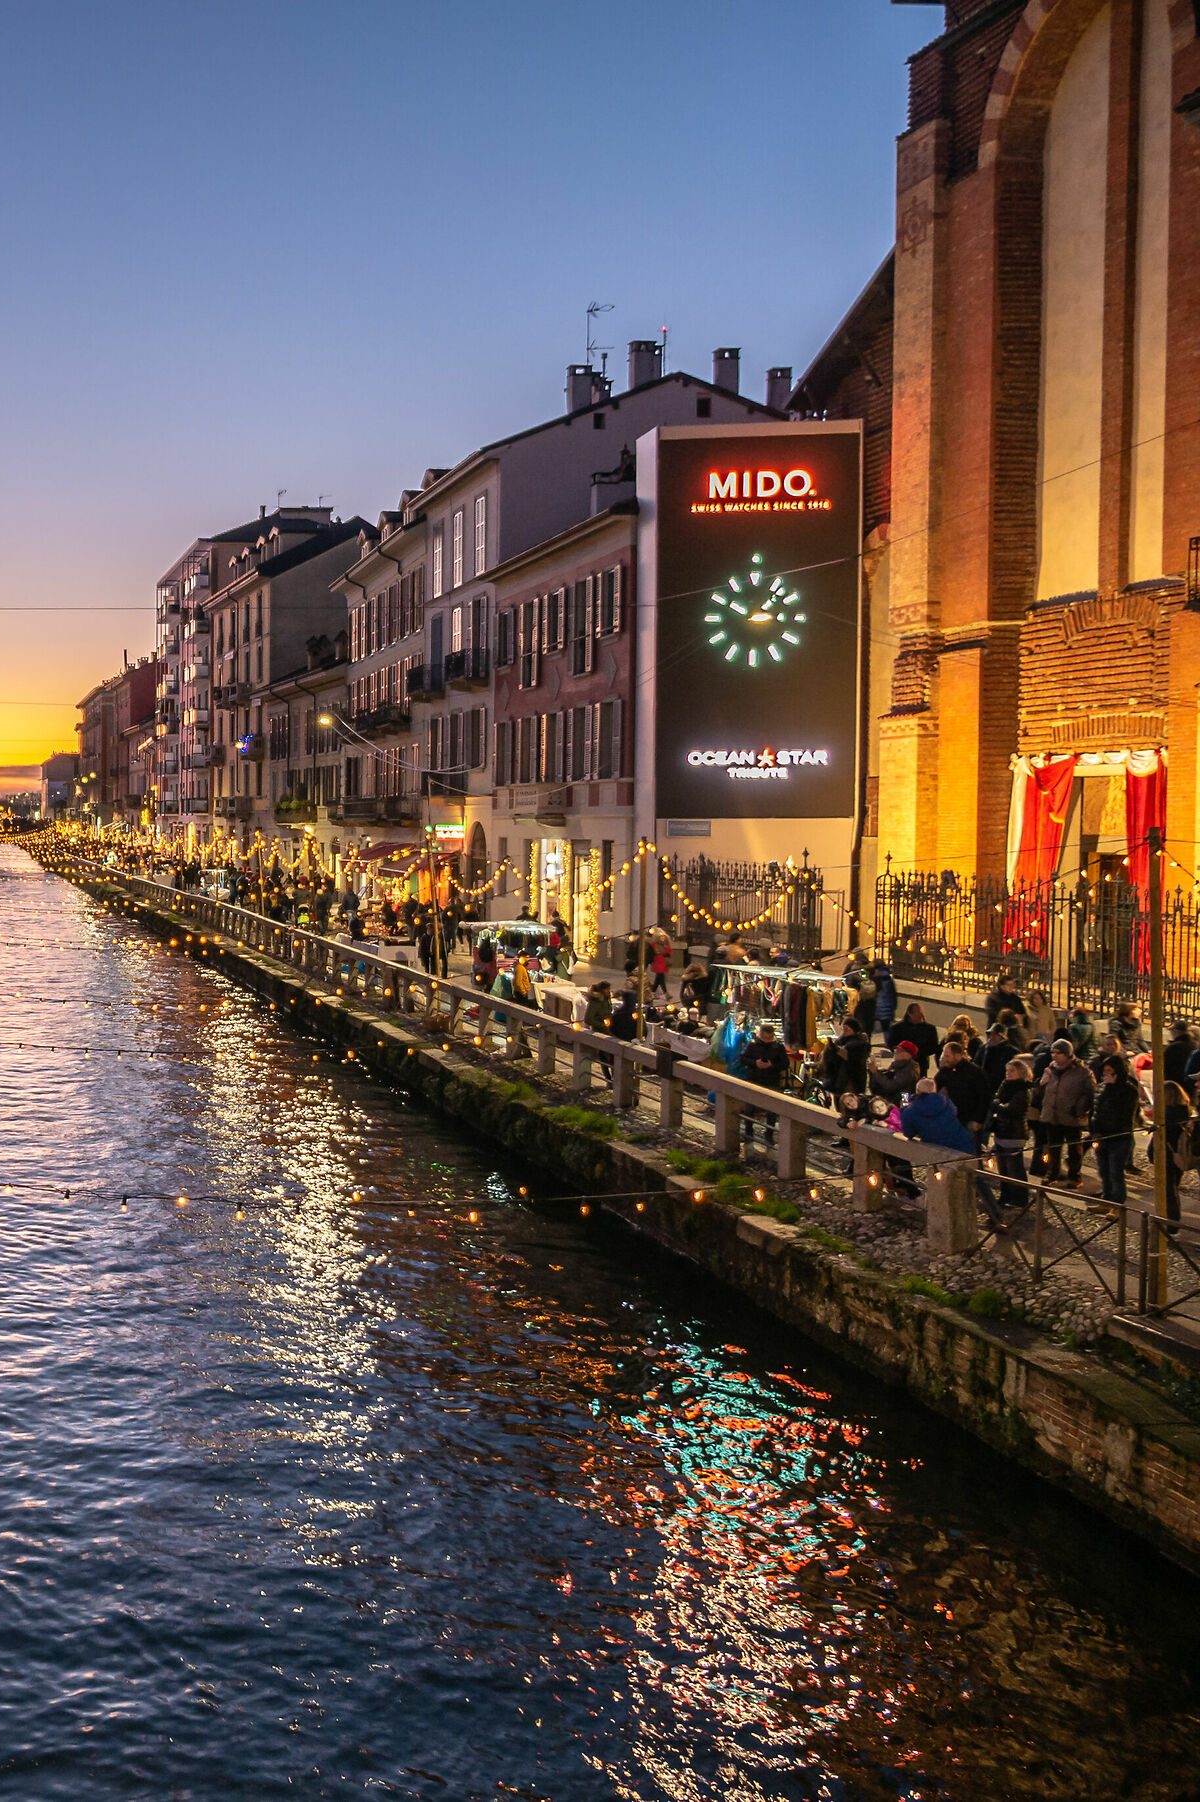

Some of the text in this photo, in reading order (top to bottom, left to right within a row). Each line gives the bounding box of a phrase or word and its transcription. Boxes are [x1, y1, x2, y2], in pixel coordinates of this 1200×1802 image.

[708, 469, 812, 499] MIDO
[690, 499, 832, 513] SWISS WATCHES SINCE 1918
[687, 750, 829, 766] OCEAN STAR
